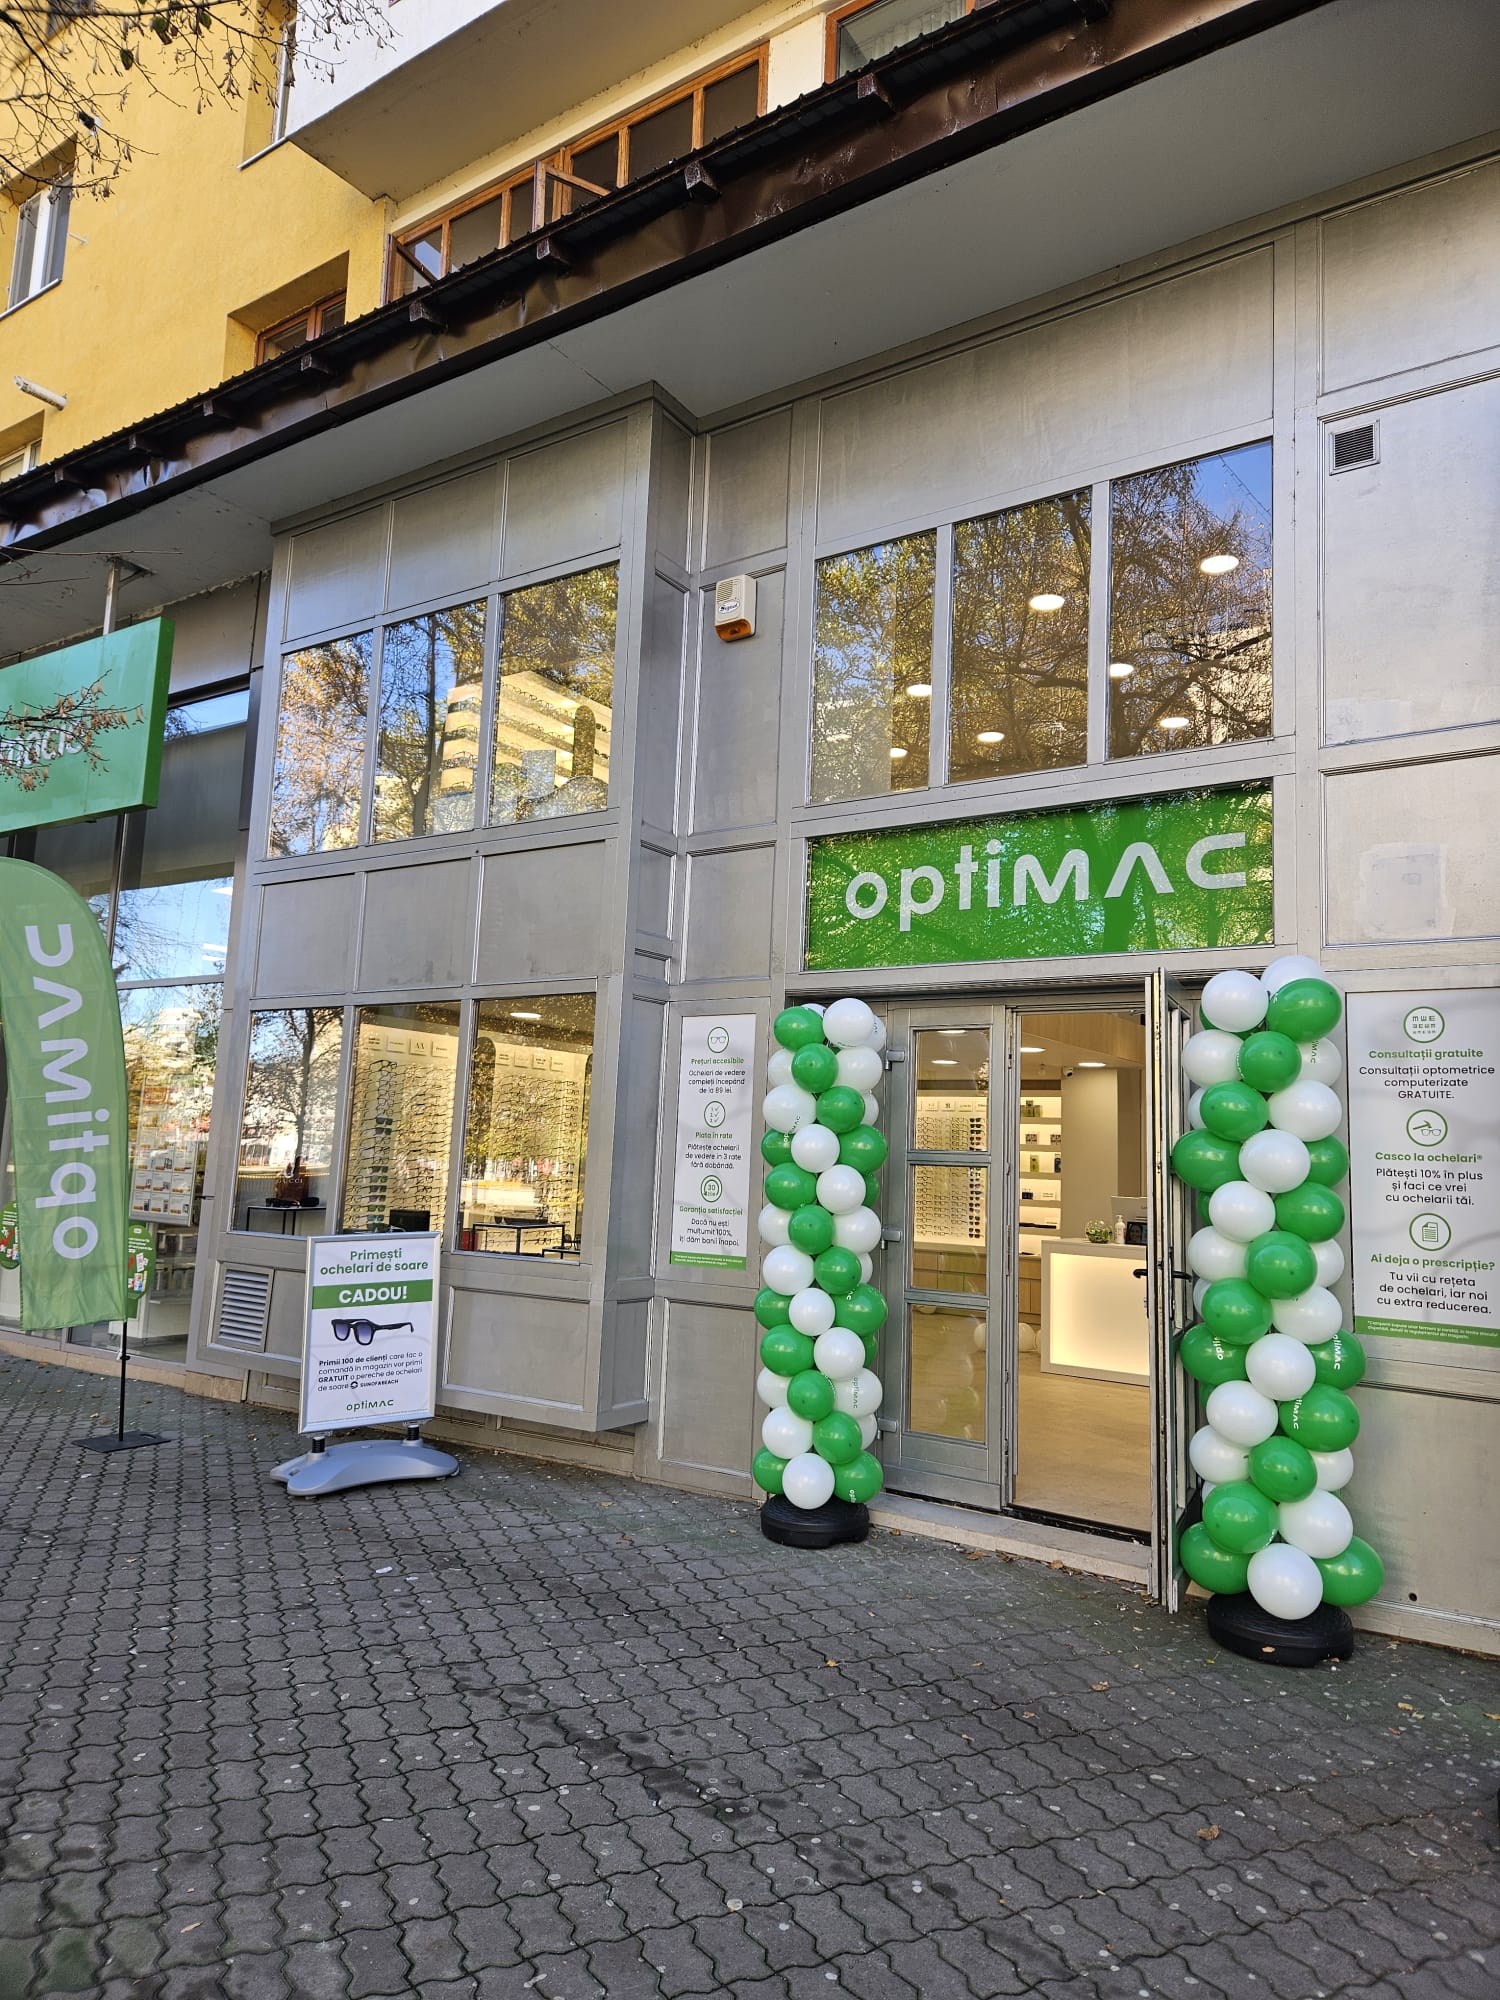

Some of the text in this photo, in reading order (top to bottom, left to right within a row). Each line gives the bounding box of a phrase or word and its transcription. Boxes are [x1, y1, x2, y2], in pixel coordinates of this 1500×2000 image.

[845, 832, 1247, 932] optiMAC
[1369, 1048, 1484, 1061] Consultații gratuite
[1359, 1065, 1495, 1077] Consultații optometrice
[1384, 1078, 1469, 1089] computerizate
[24, 923, 110, 1260] optiMAC
[1398, 1090, 1455, 1099] GRATUITE.
[1375, 1152, 1411, 1161] Casco
[1414, 1153, 1425, 1162] la
[1376, 1168, 1417, 1180] Plătești
[1420, 1169, 1441, 1179] 10%
[1458, 1171, 1483, 1181] plus
[1404, 1181, 1425, 1190] faci
[1445, 1183, 1467, 1192] vrei
[1385, 1194, 1475, 1205] cu ochelarii tăi.
[350, 1248, 402, 1262] Primești
[320, 1261, 429, 1275] ochelari de soare
[1371, 1254, 1382, 1263] Ai
[1385, 1254, 1410, 1266] deja
[1422, 1258, 1496, 1272] prescripție?
[1389, 1272, 1476, 1288] Tu vii cu rețeta
[338, 1286, 408, 1303] CADOU!
[1379, 1283, 1488, 1301] de ochelari, iar noi
[1377, 1297, 1492, 1314] cu extra reducerea.
[319, 1358, 341, 1367] Primii
[362, 1363, 393, 1373] magazin
[406, 1359, 423, 1367] primi
[318, 1375, 349, 1383] GRATUIT
[356, 1371, 384, 1381] pereche
[395, 1367, 423, 1376] ochelari
[318, 1384, 328, 1392] de
[328, 1383, 349, 1391] soare
[346, 1399, 394, 1413] optiMAC
